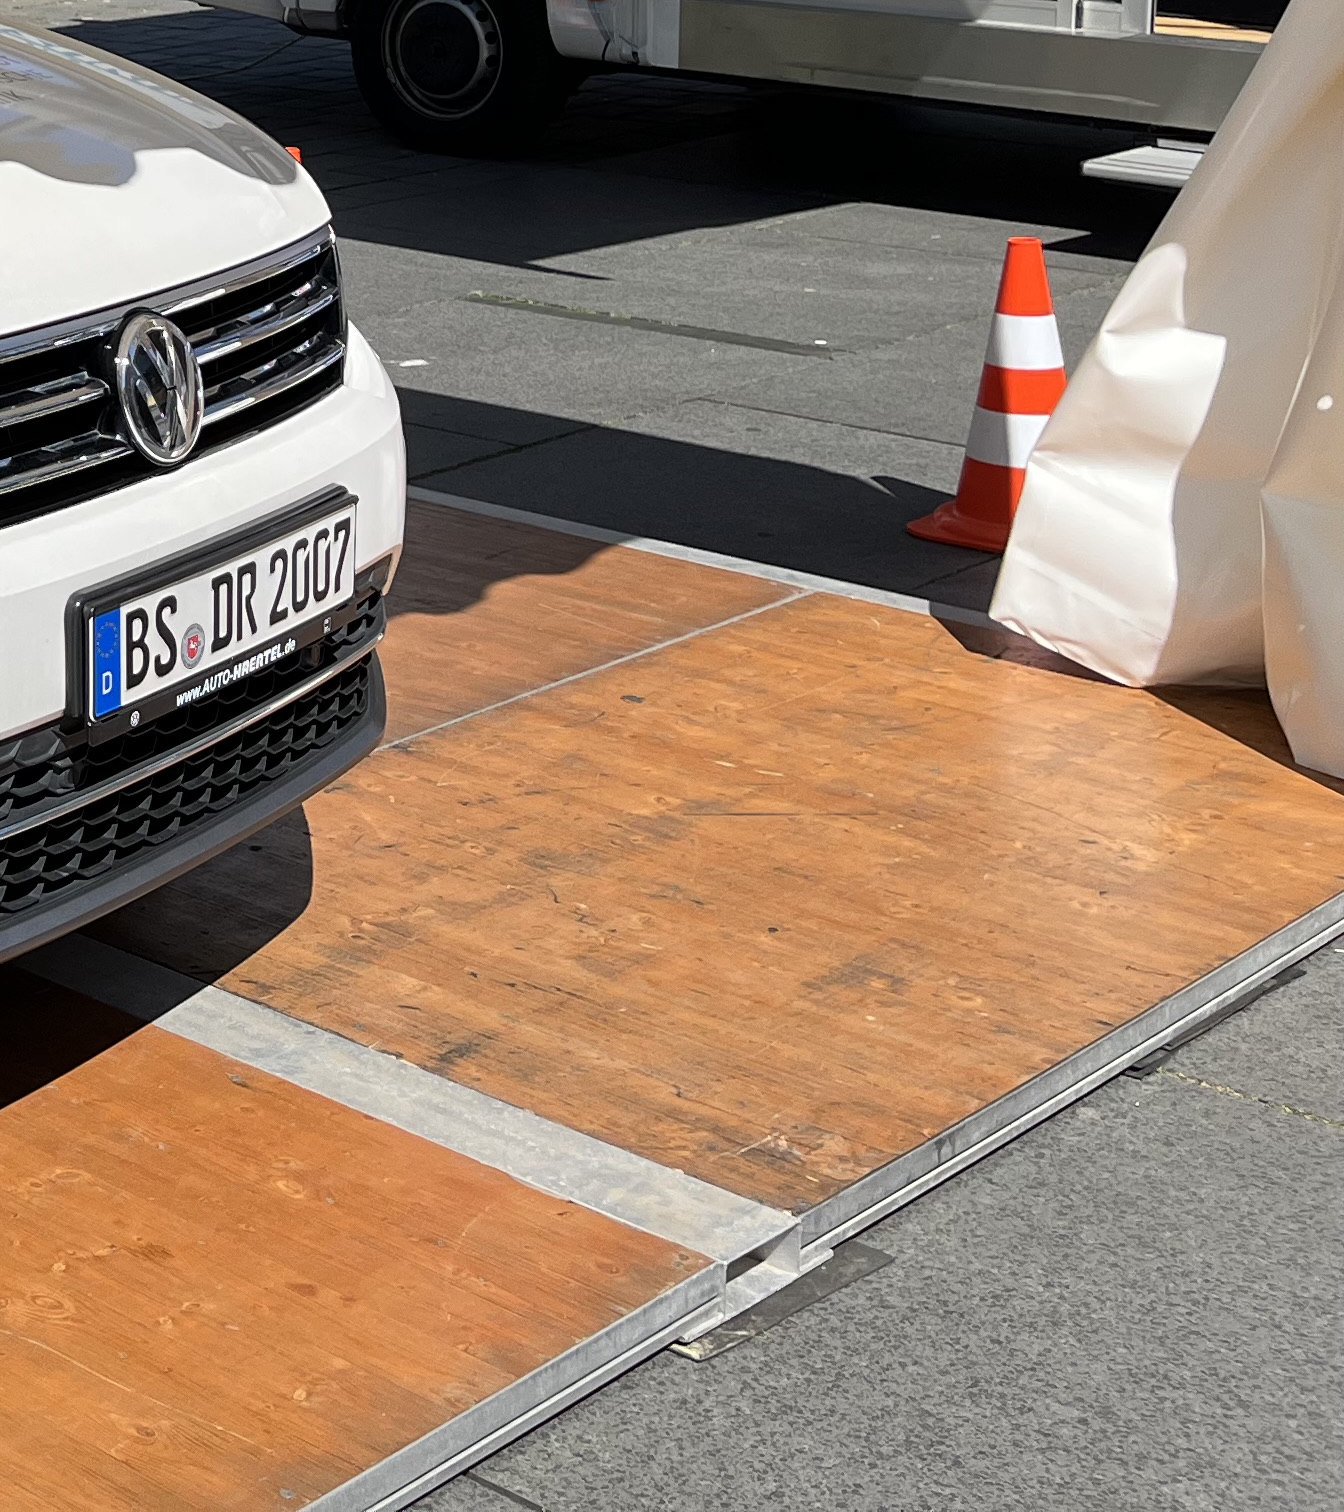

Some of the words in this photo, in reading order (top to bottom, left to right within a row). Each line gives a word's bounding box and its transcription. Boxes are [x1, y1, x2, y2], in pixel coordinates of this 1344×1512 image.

[124, 594, 178, 692] BS
[210, 560, 258, 655] DR
[268, 515, 352, 628] 2007
[101, 669, 114, 695] D
